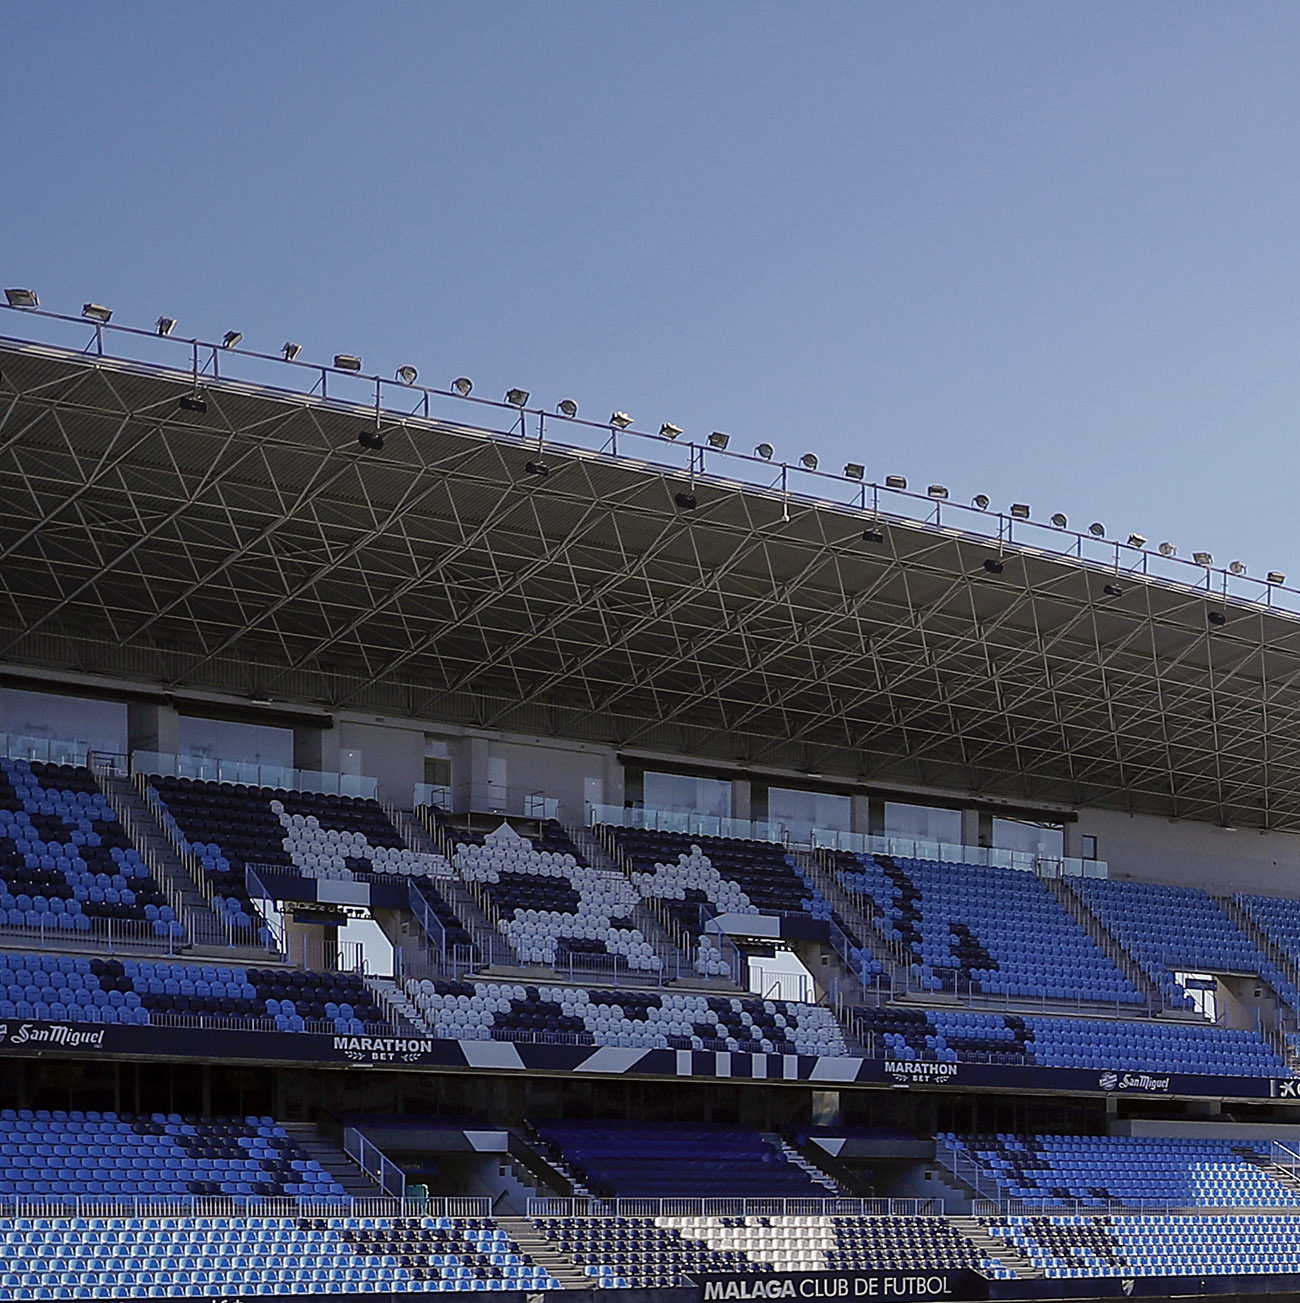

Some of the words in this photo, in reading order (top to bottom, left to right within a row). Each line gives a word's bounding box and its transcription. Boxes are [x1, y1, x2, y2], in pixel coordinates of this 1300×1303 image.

[333, 1036, 432, 1053] MARATHON
[371, 1052, 395, 1060] BET
[884, 1061, 958, 1075] MARATHON
[704, 1279, 797, 1300] MALAGA
[799, 1278, 849, 1298] CLUB
[854, 1277, 879, 1296] DE
[884, 1276, 952, 1295] FUTBOL
